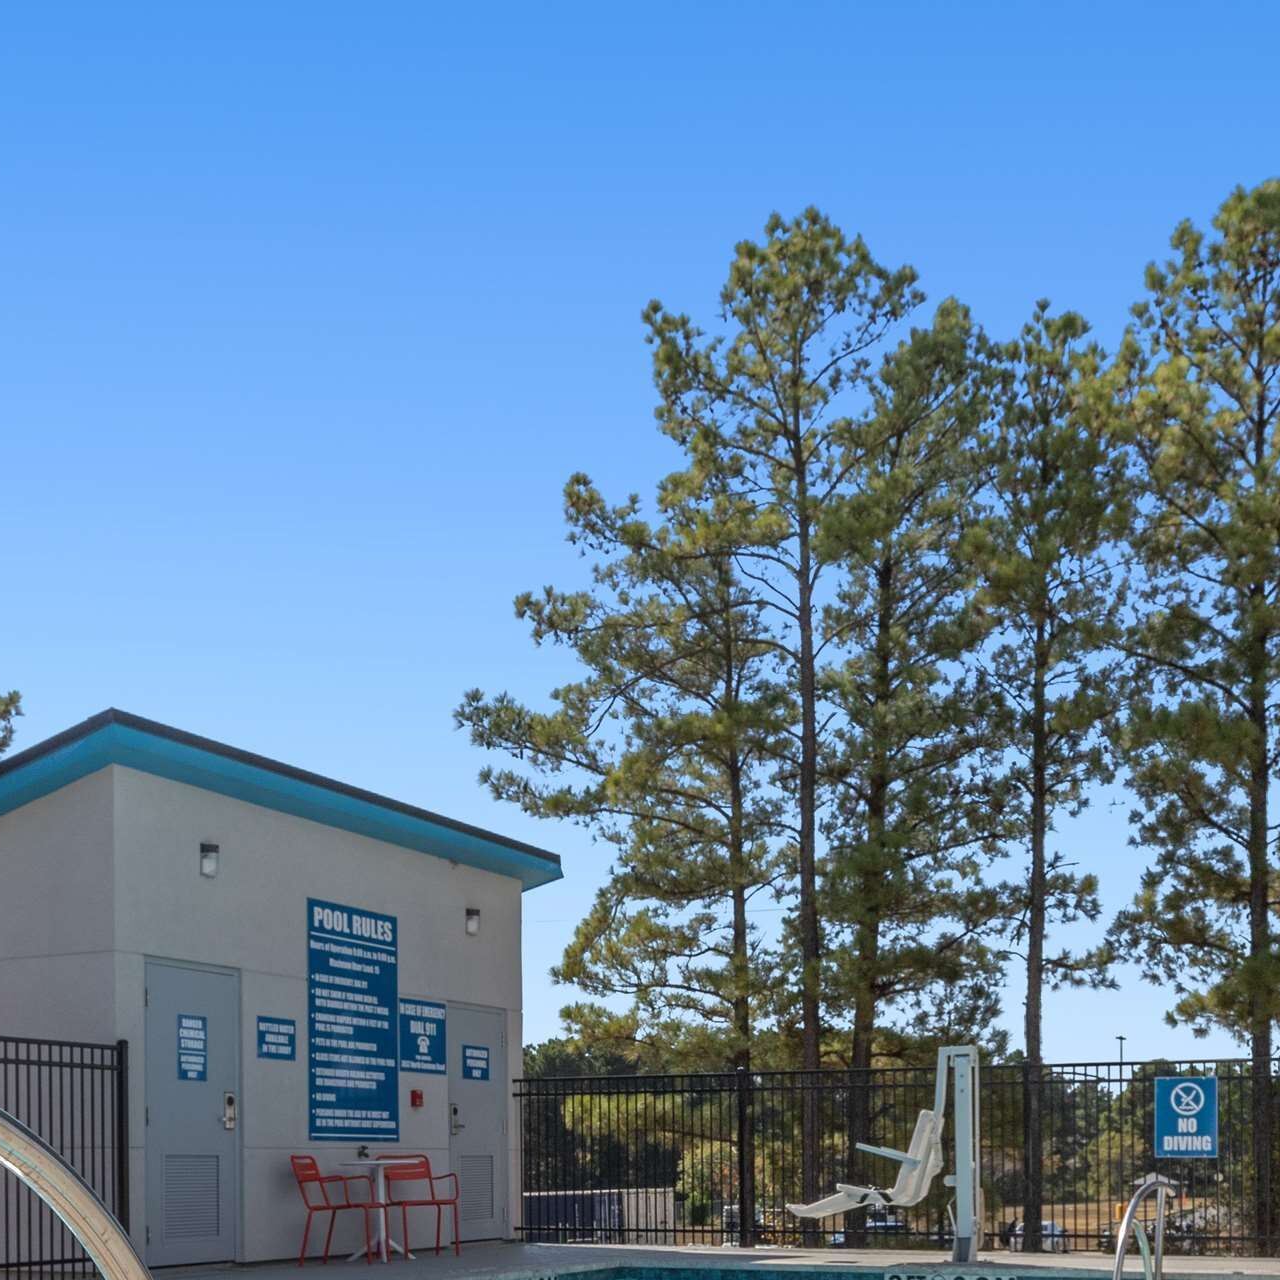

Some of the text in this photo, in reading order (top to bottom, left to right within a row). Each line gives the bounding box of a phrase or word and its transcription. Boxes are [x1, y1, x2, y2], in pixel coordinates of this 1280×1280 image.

[313, 906, 393, 943] POOL RULES
[410, 1020, 437, 1036] DIAL 911
[1178, 1117, 1197, 1133] NO
[1163, 1136, 1212, 1151] DIVING
